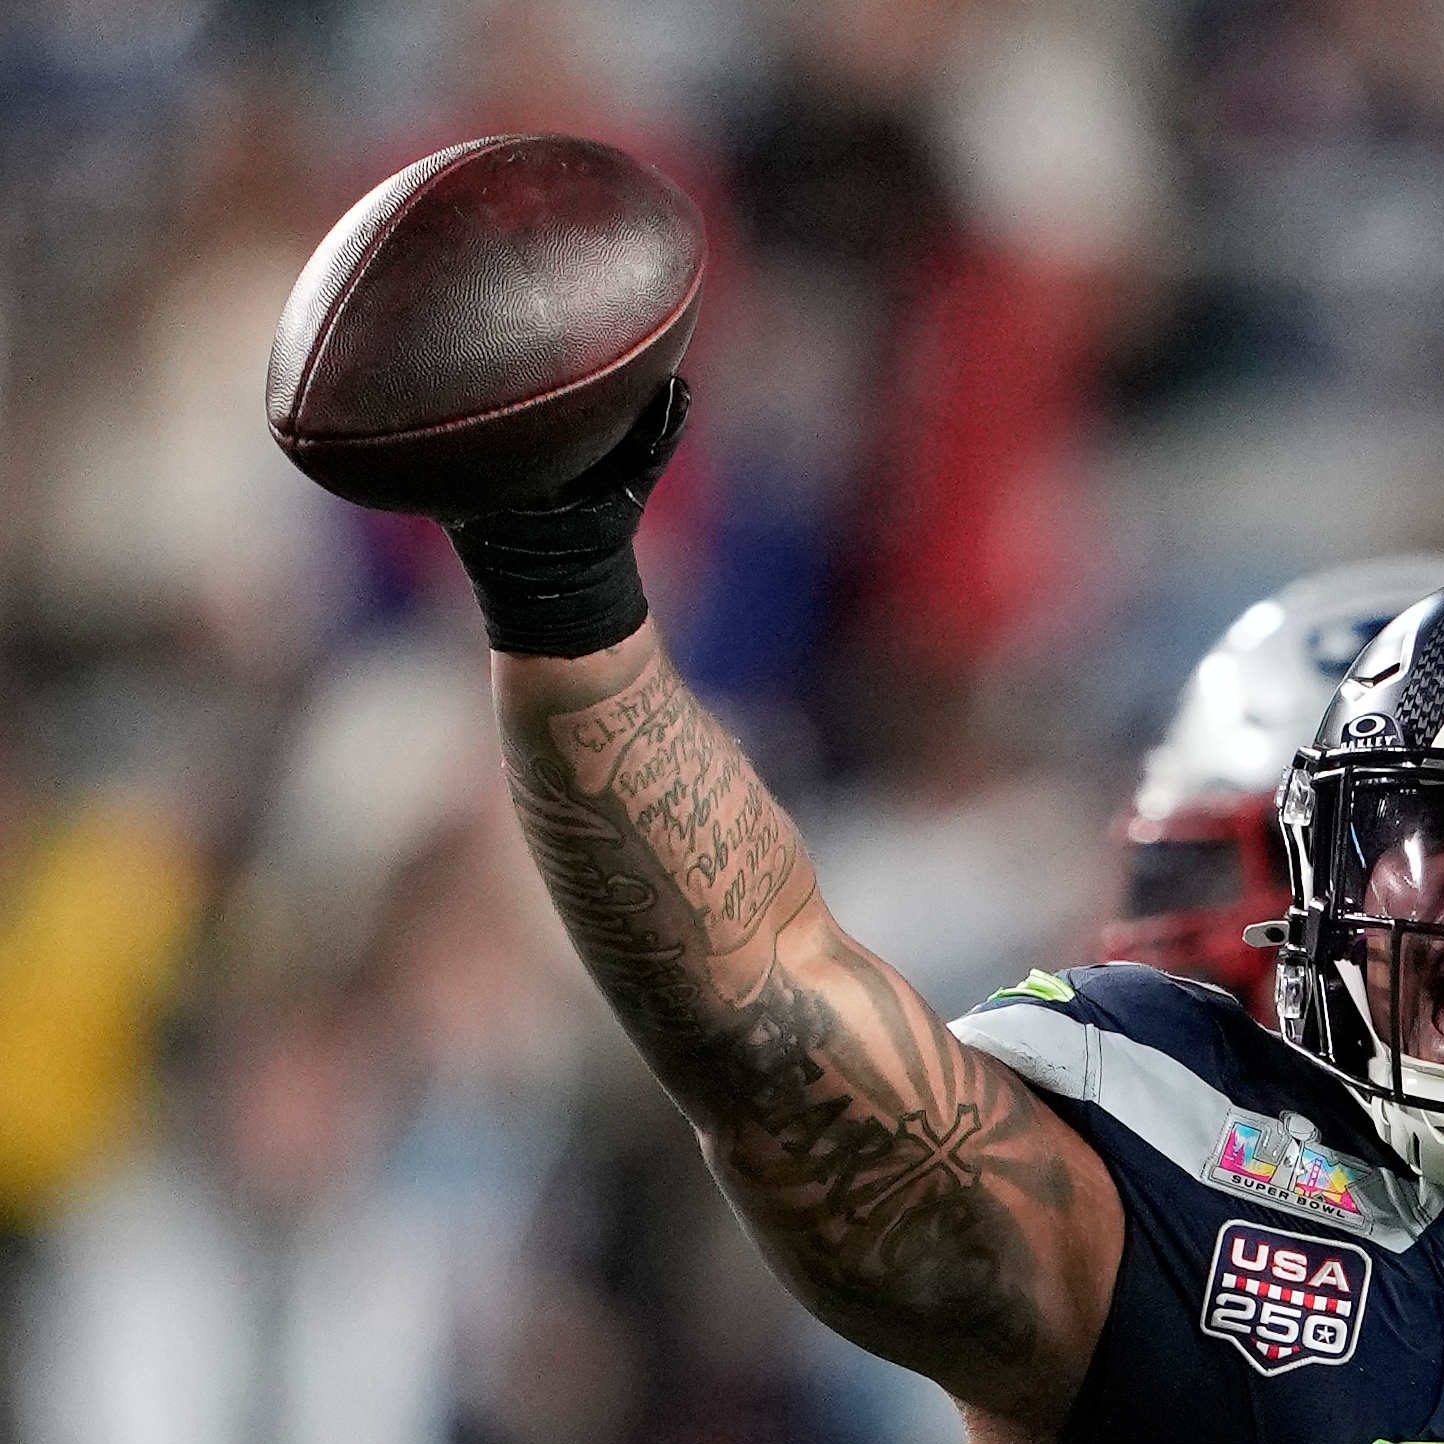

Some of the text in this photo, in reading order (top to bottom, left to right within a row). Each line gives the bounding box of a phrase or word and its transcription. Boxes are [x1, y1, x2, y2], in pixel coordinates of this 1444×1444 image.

[1231, 1174, 1346, 1219] SUPER BOWL
[1230, 1235, 1351, 1294] USA
[1211, 1292, 1348, 1354] 250
